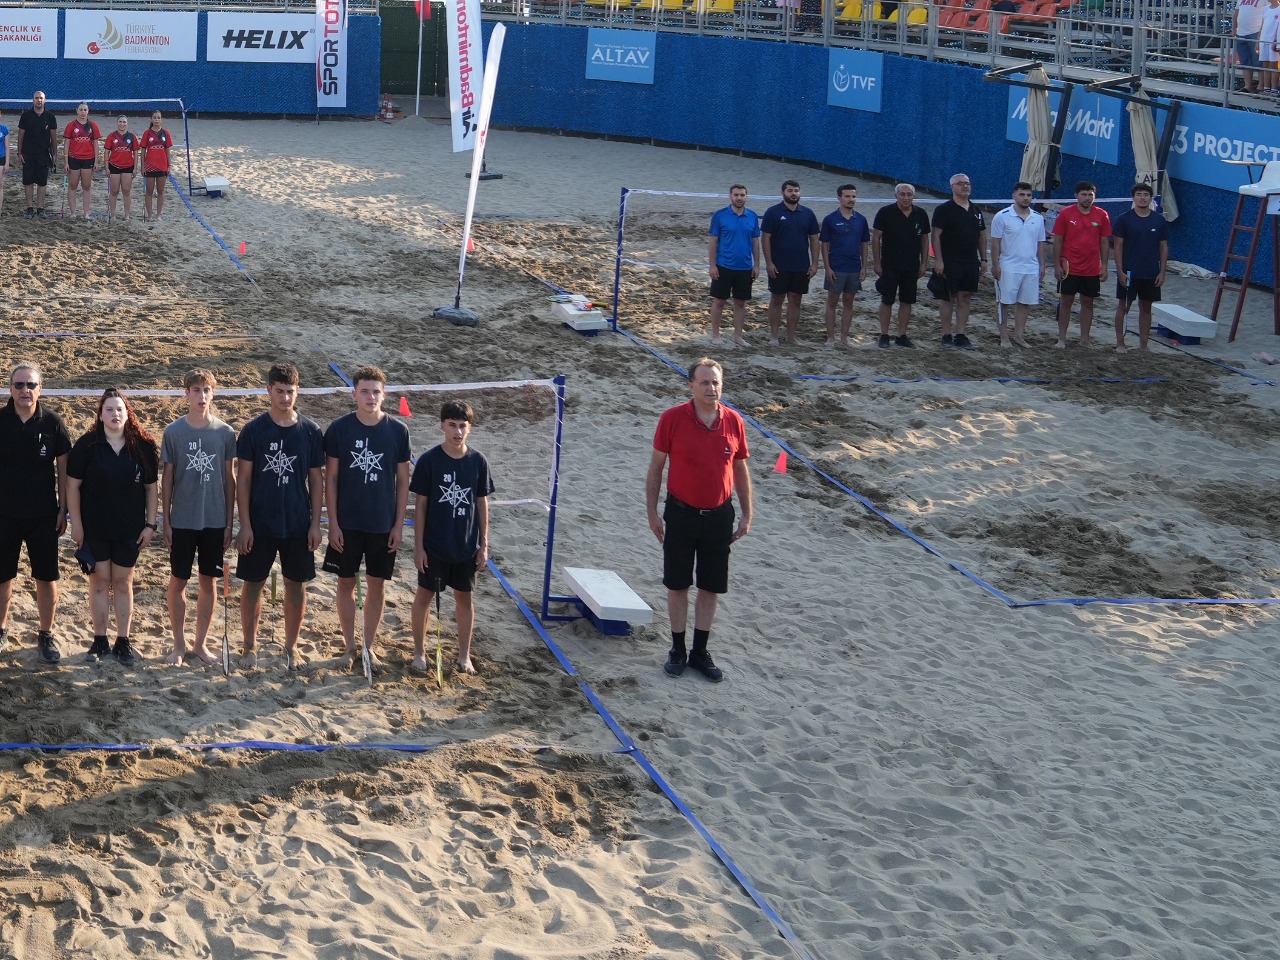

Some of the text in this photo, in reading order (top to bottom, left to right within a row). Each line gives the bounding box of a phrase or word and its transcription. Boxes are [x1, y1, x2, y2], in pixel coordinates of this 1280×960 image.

[30, 25, 42, 33] VE
[221, 29, 309, 49] HELIX
[591, 47, 651, 64] ALTAV
[851, 74, 876, 91] TVF
[1011, 97, 1115, 140] MMarkt
[188, 441, 197, 451] 20
[269, 442, 279, 451] 20
[355, 439, 364, 449] 20
[369, 472, 378, 482] 24
[443, 473, 452, 483] 20
[457, 507, 466, 517] 24
